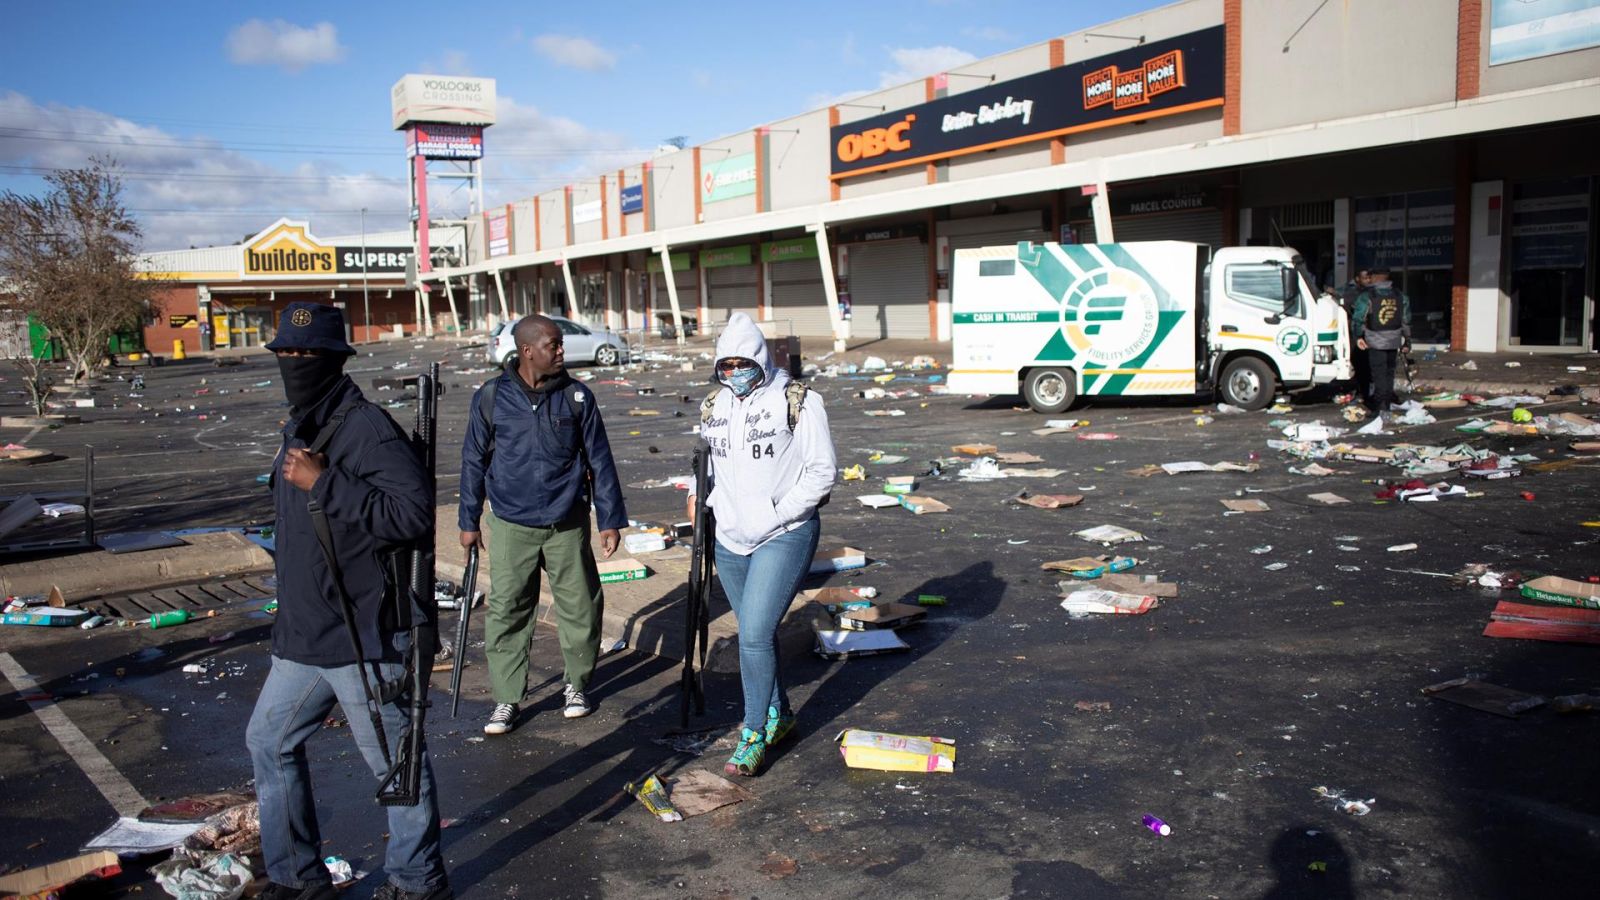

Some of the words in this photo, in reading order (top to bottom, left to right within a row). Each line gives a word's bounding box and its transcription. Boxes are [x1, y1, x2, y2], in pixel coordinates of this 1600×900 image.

[1147, 55, 1175, 71] EXPECT
[1086, 71, 1111, 86] EXPECT
[1116, 72, 1142, 86] EXPECT
[1148, 64, 1175, 83] MORE
[424, 80, 483, 91] VOSLOORUS
[1087, 80, 1112, 97] MORE
[1116, 81, 1143, 98] MORE
[1149, 77, 1175, 93] VALUE
[423, 91, 482, 101] CROSSING
[1116, 94, 1141, 106] SERVICE
[837, 117, 912, 163] OBC
[1130, 202, 1159, 213] PARCEL
[1161, 198, 1203, 210] COUNTER
[1366, 240, 1394, 248] SOCIAL
[249, 249, 331, 271] builders
[344, 252, 407, 267] SUPERS
[973, 312, 994, 322] CASH
[995, 312, 1004, 322] IN
[1005, 312, 1038, 322] TRANSIT
[1088, 348, 1123, 360] FIDELITY
[1124, 322, 1153, 355] SERVICES
[752, 443, 775, 459] 84
